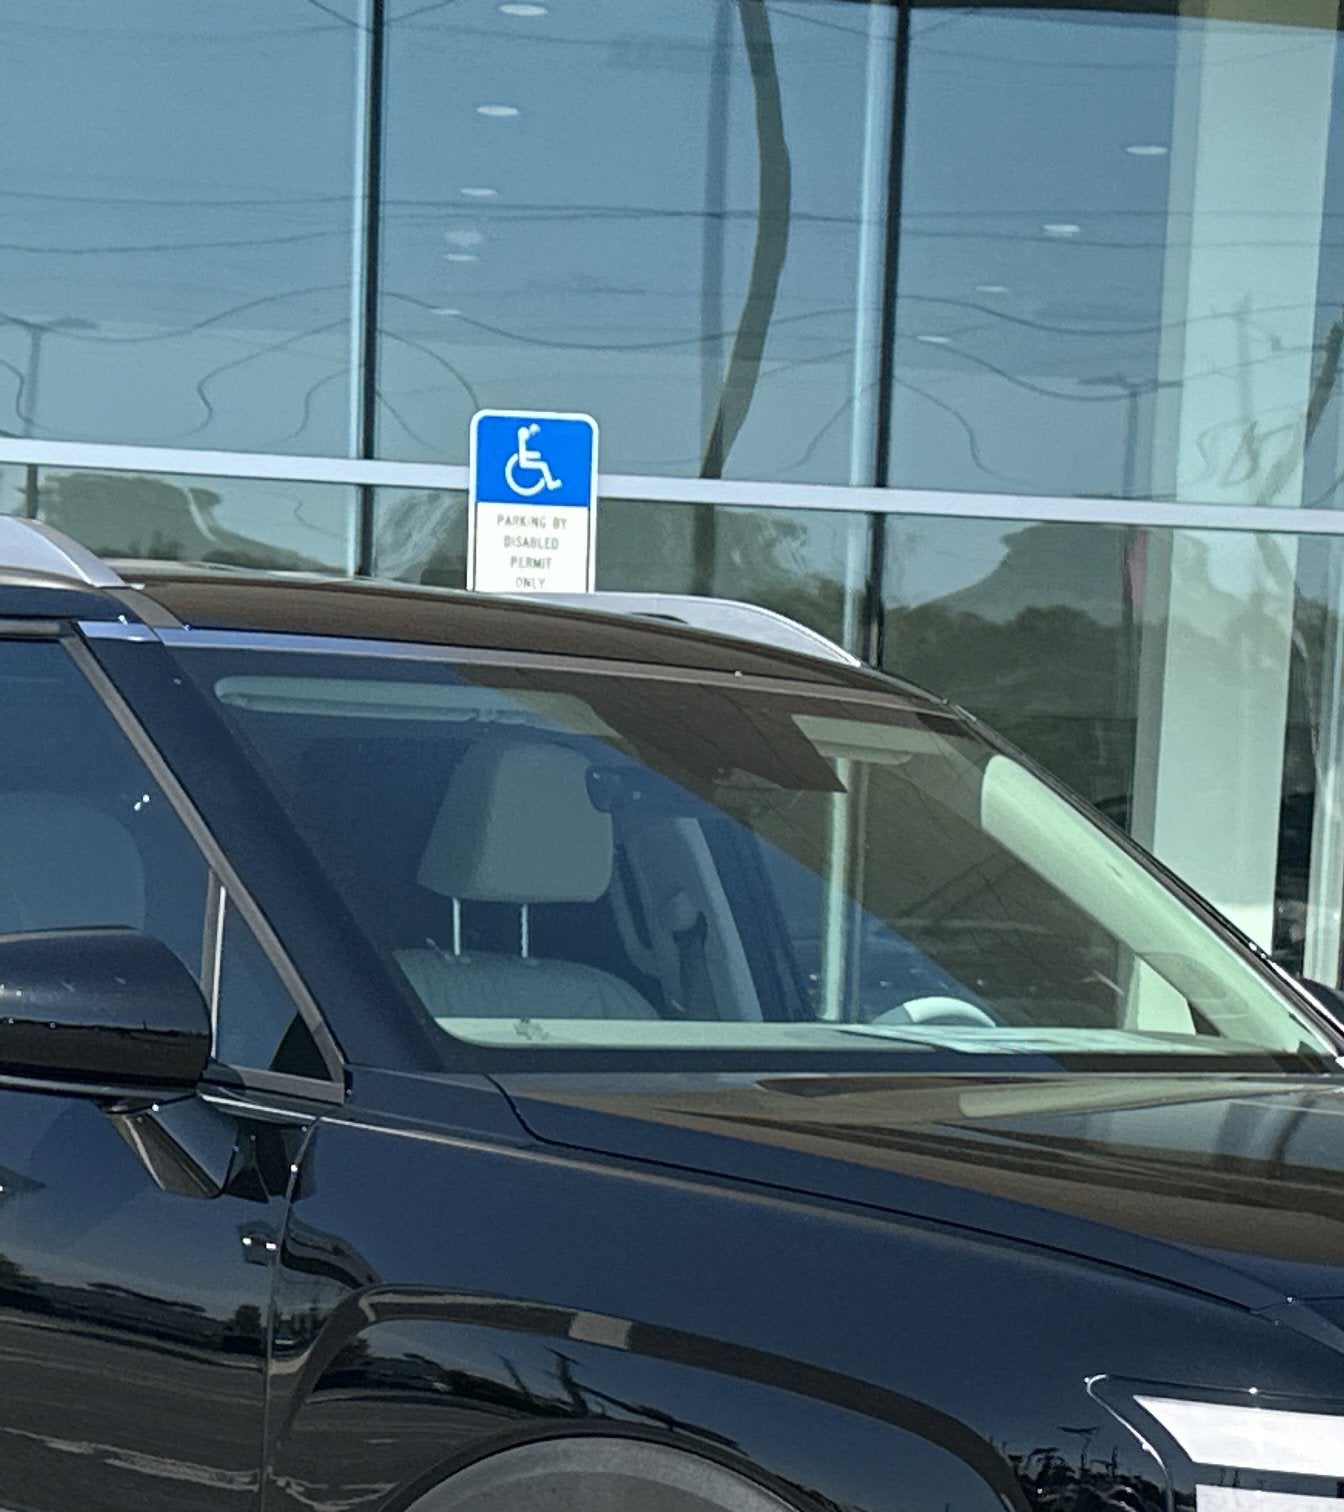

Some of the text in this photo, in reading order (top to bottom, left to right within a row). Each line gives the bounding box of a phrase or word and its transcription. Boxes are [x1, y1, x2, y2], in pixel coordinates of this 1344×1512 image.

[497, 514, 567, 529] PARKING BY
[504, 535, 559, 550] DISABLED
[510, 555, 552, 569] PERMIT
[515, 576, 546, 589] ONLY
